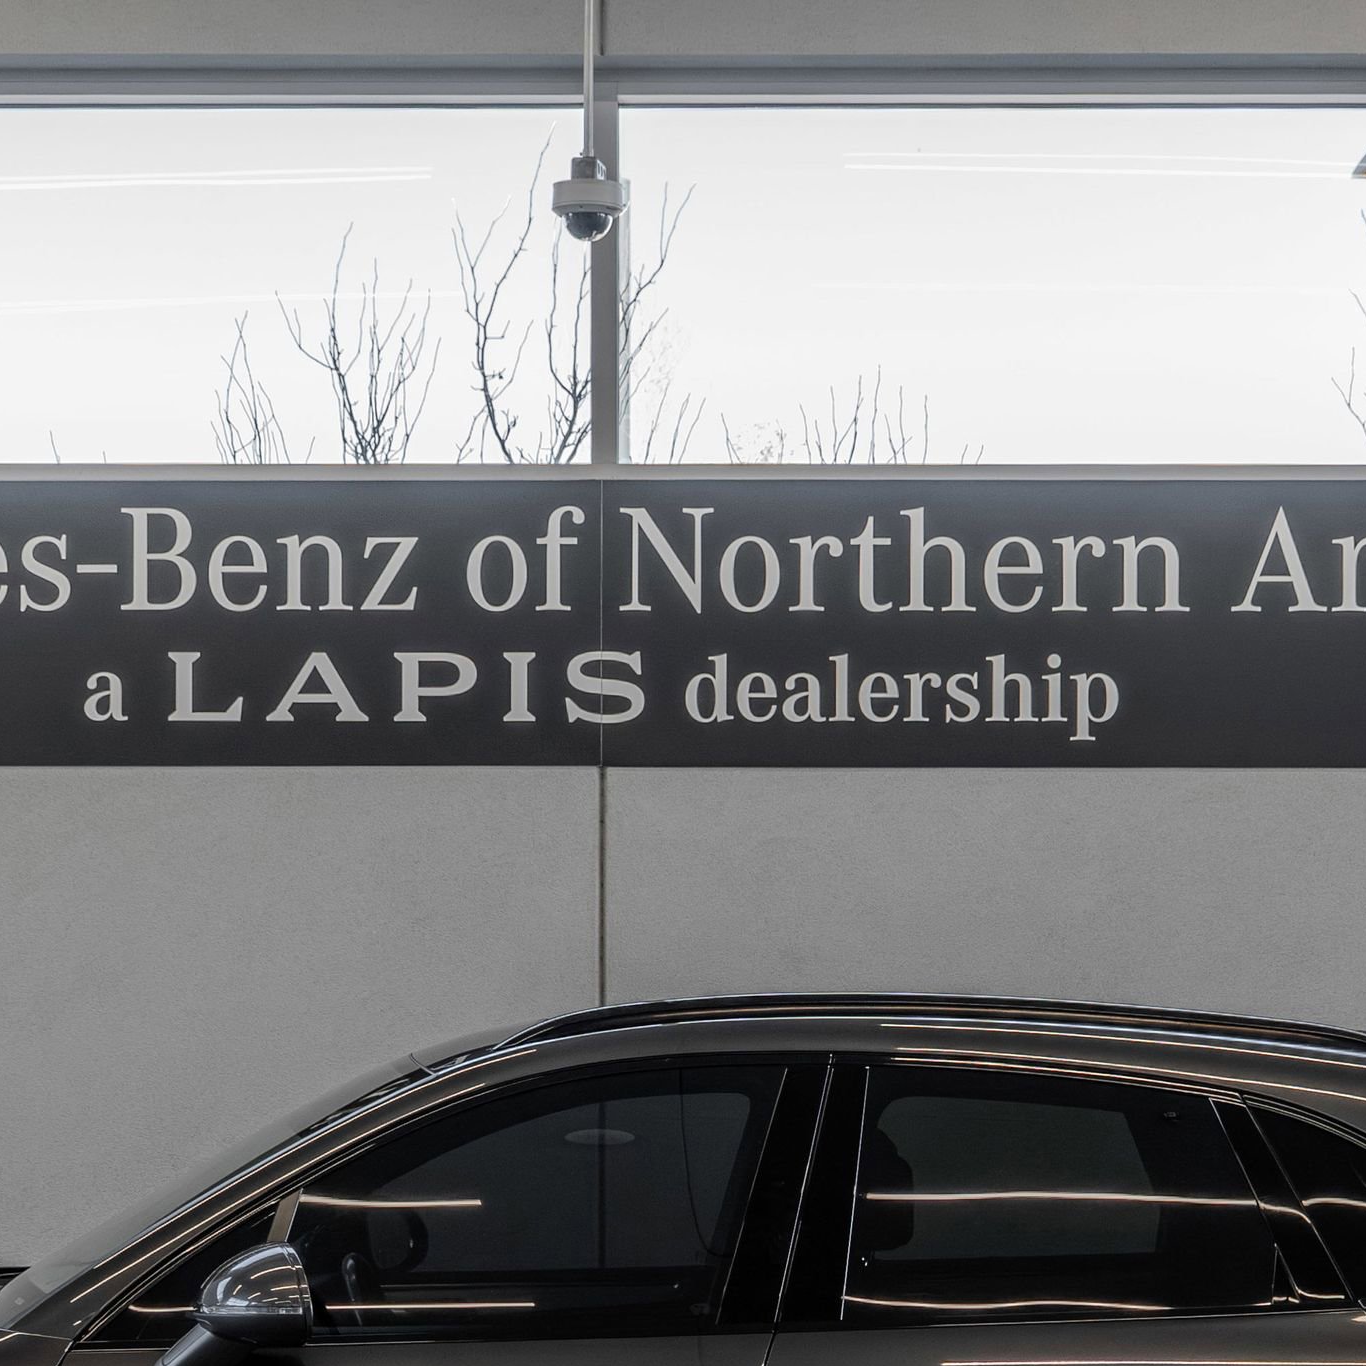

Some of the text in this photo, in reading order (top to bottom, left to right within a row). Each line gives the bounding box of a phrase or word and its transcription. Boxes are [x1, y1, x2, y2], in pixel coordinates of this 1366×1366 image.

[465, 504, 586, 612] of
[618, 505, 1191, 614] Northern
[82, 649, 1119, 741] a LAPIS dealership
